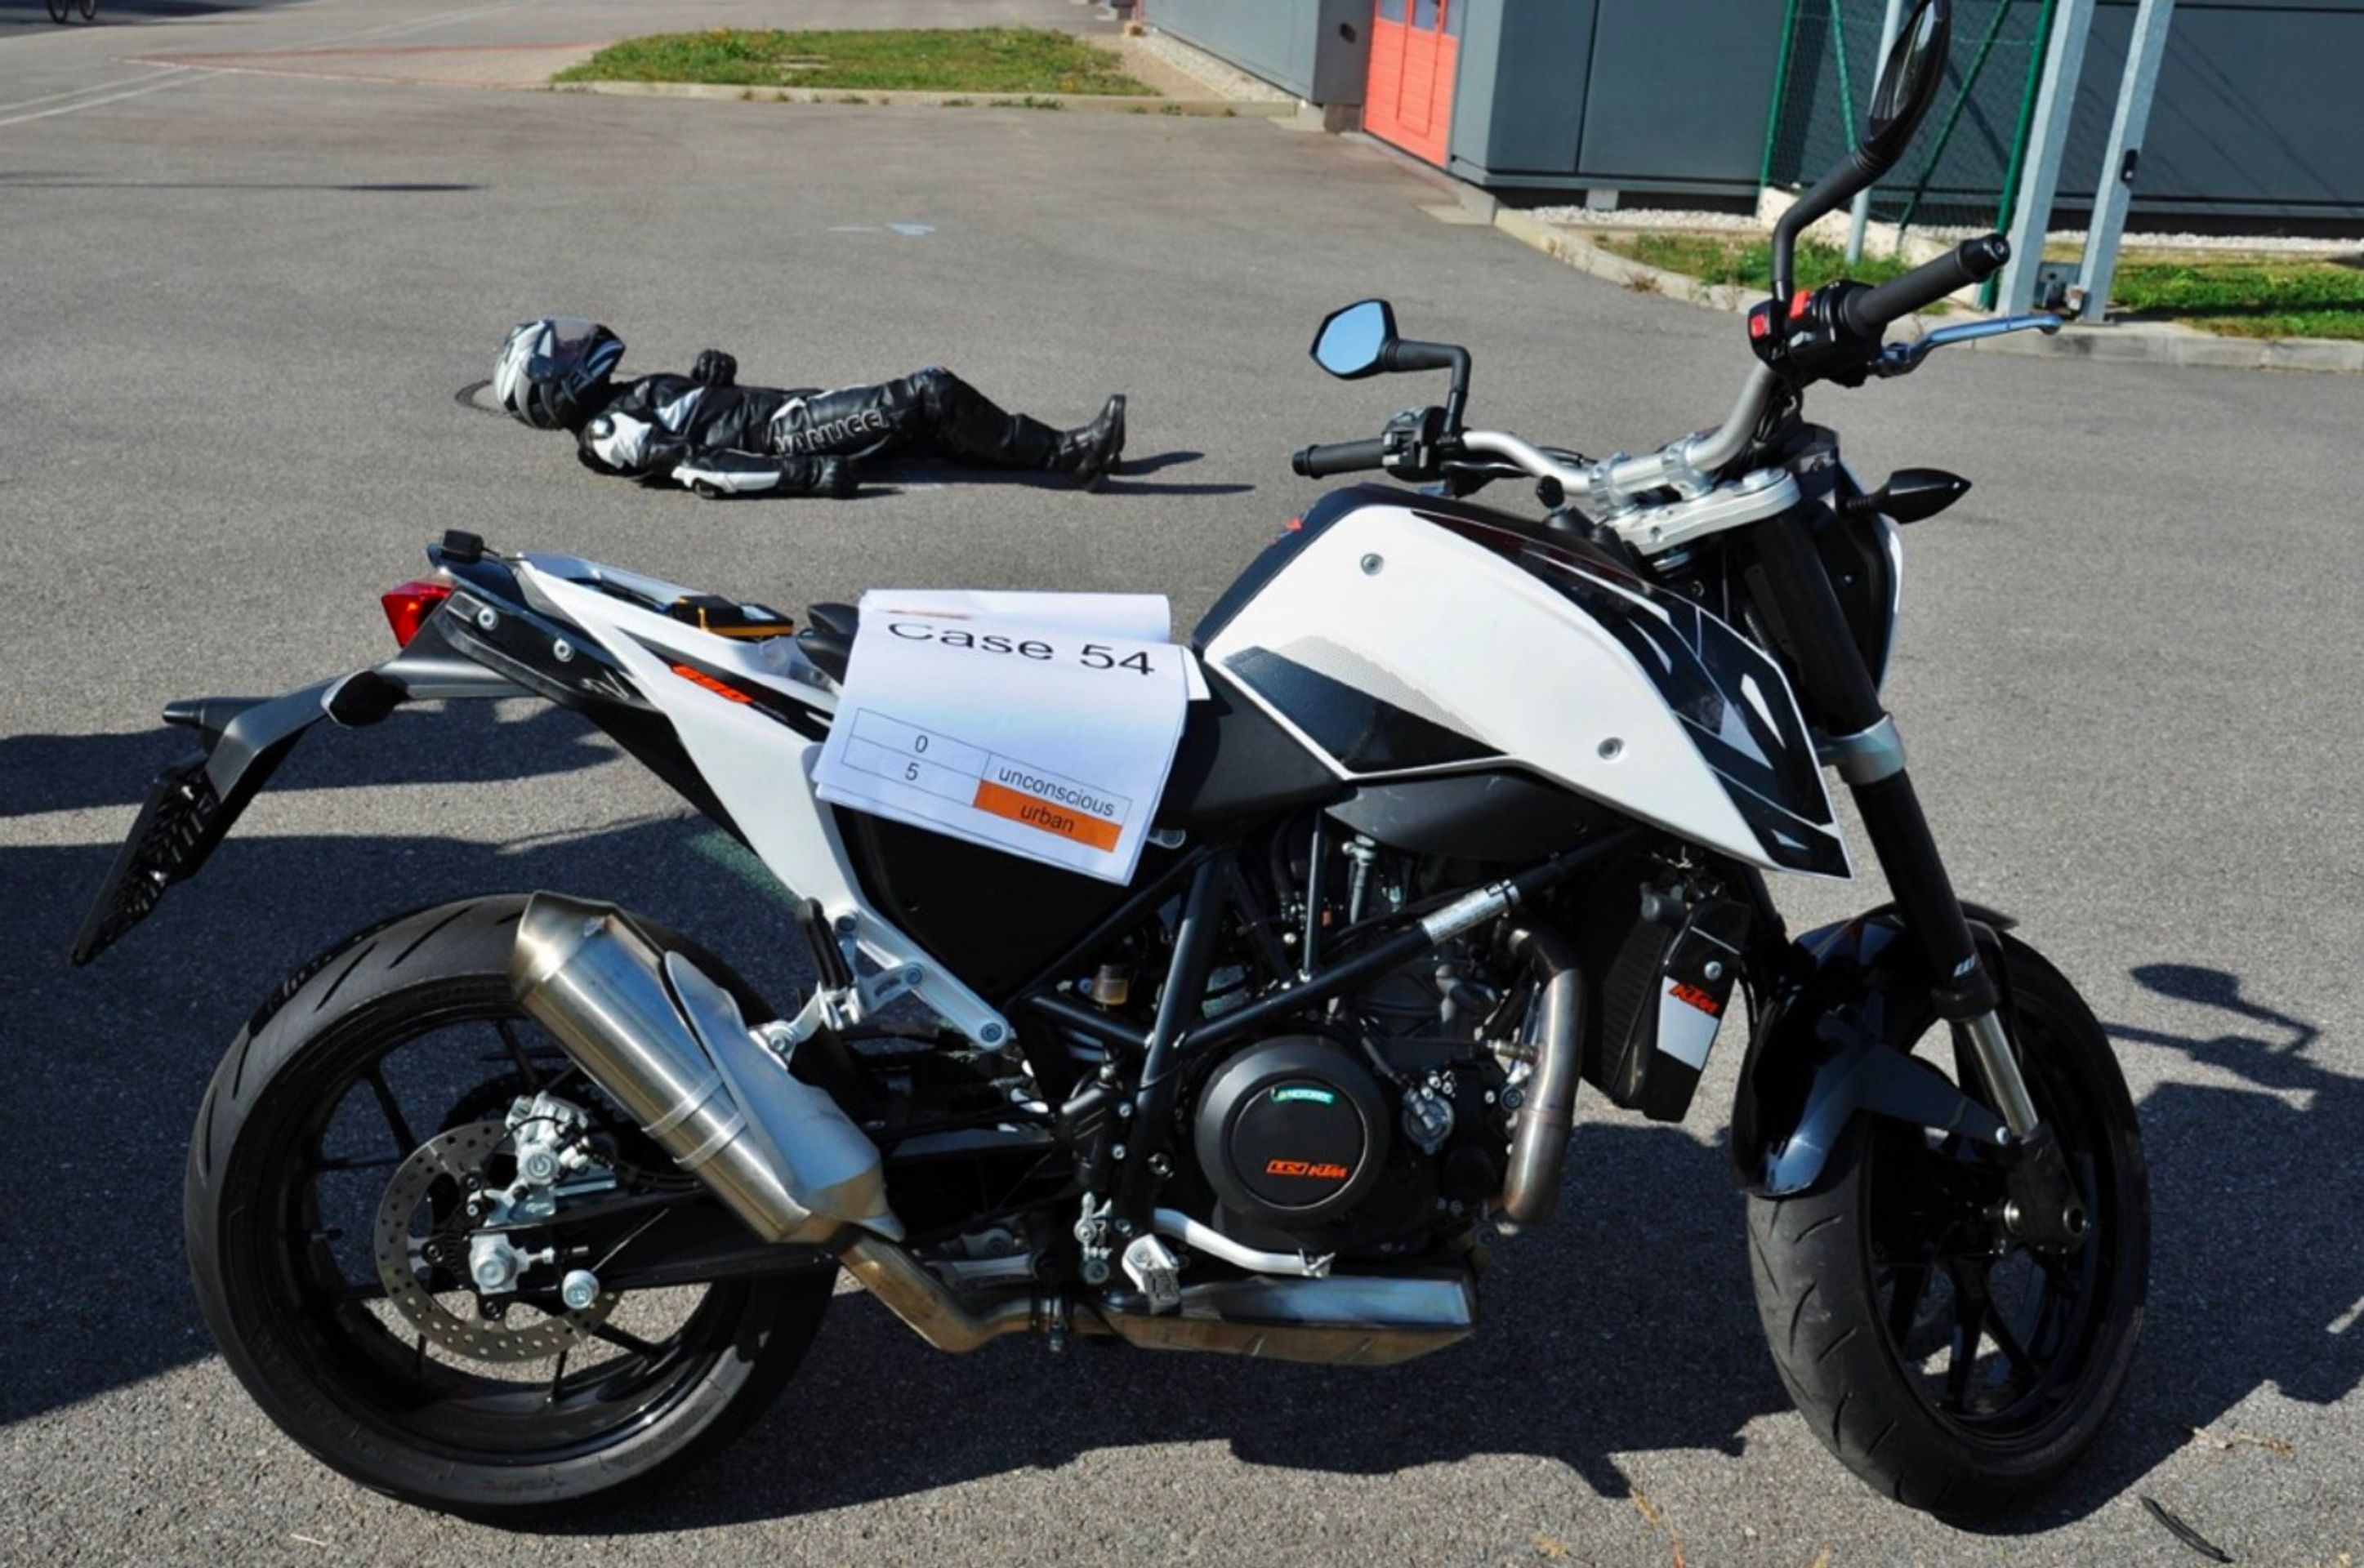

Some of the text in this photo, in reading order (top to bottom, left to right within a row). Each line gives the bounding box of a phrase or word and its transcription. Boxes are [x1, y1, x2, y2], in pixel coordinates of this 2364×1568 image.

[887, 621, 1155, 676] Case 54
[904, 763, 1075, 835] 5 urban
[915, 735, 1116, 818] 0 unconscious
